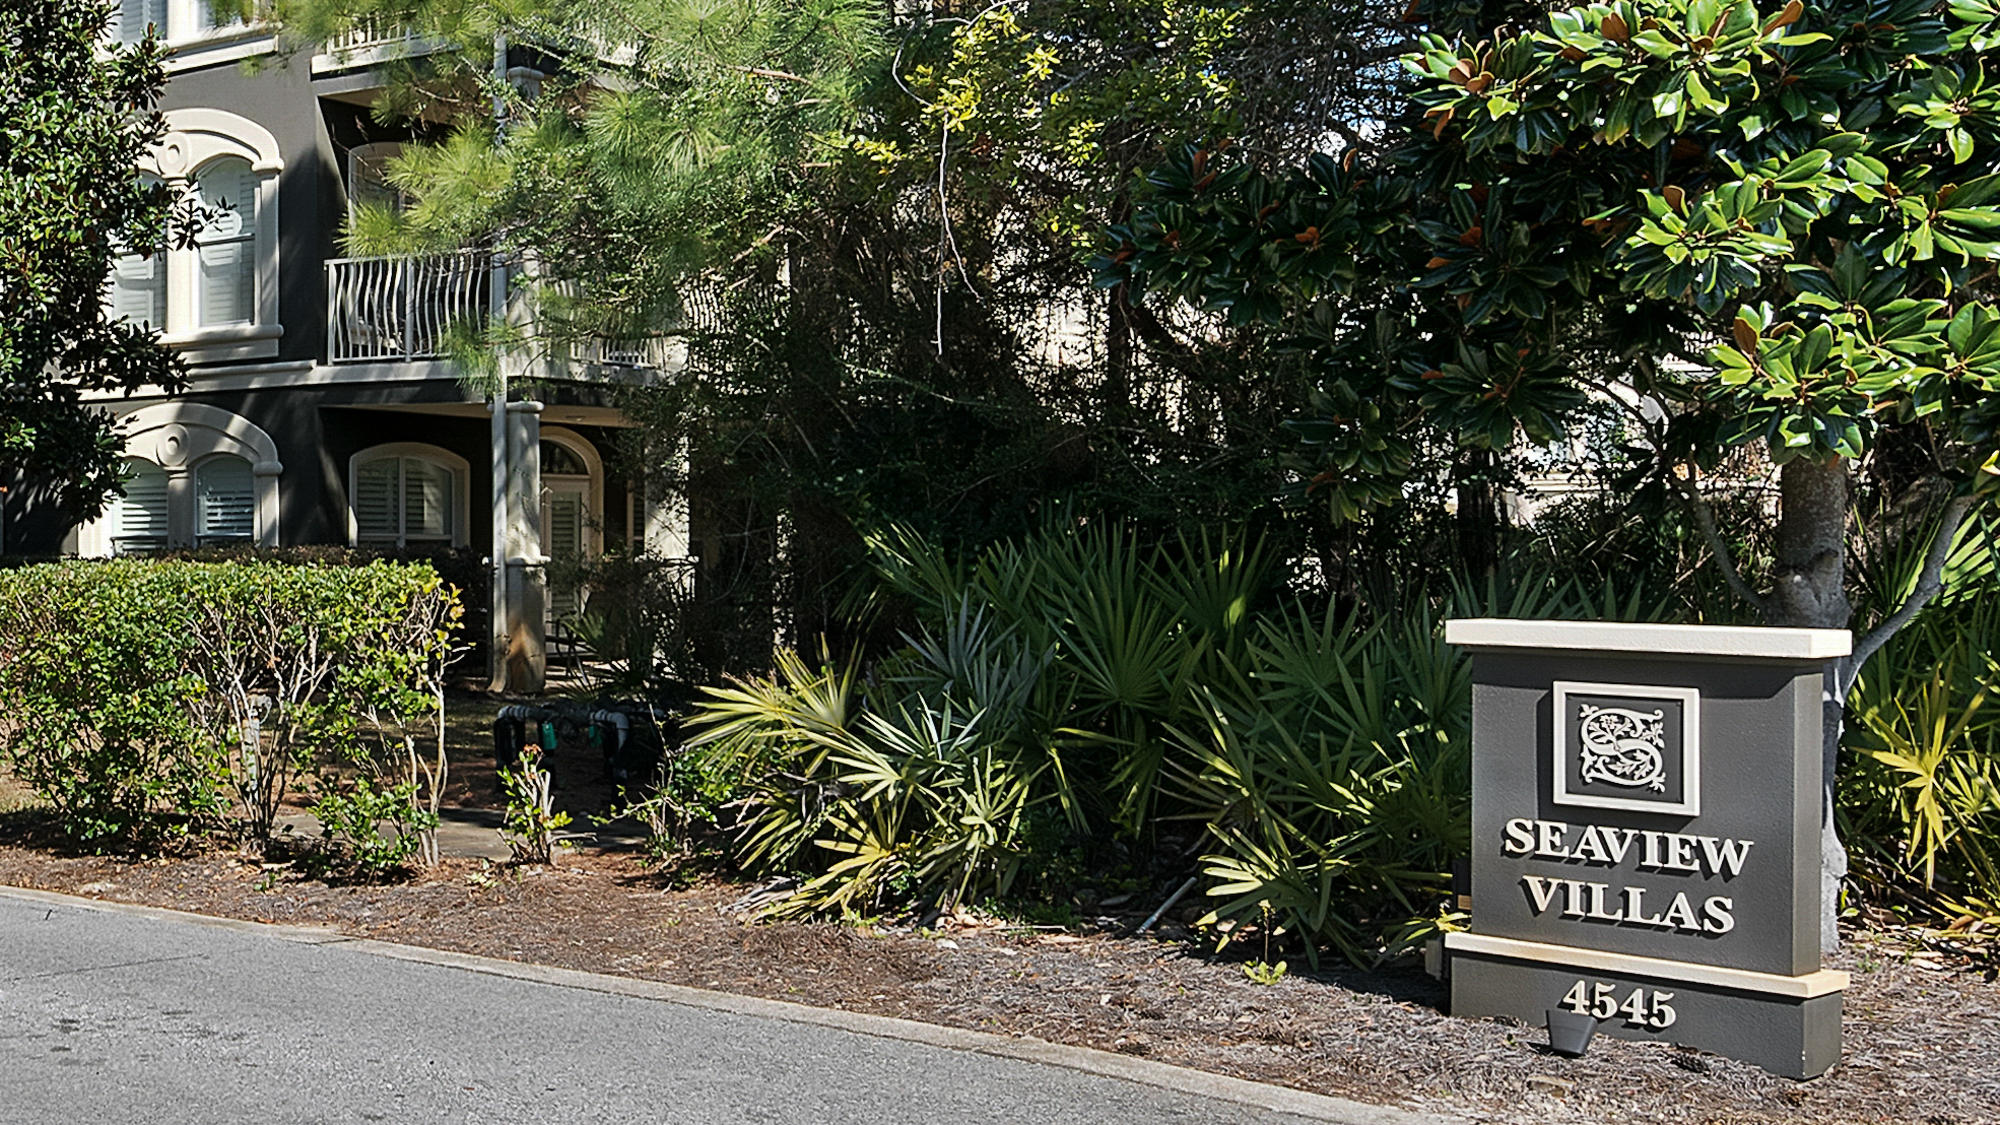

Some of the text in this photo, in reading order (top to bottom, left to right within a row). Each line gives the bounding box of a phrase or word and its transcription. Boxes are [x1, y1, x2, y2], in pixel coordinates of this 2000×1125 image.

[1504, 818, 1755, 877] SEAVIEW
[1522, 874, 1735, 934] VILLAS
[1562, 979, 1677, 1029] 4545
